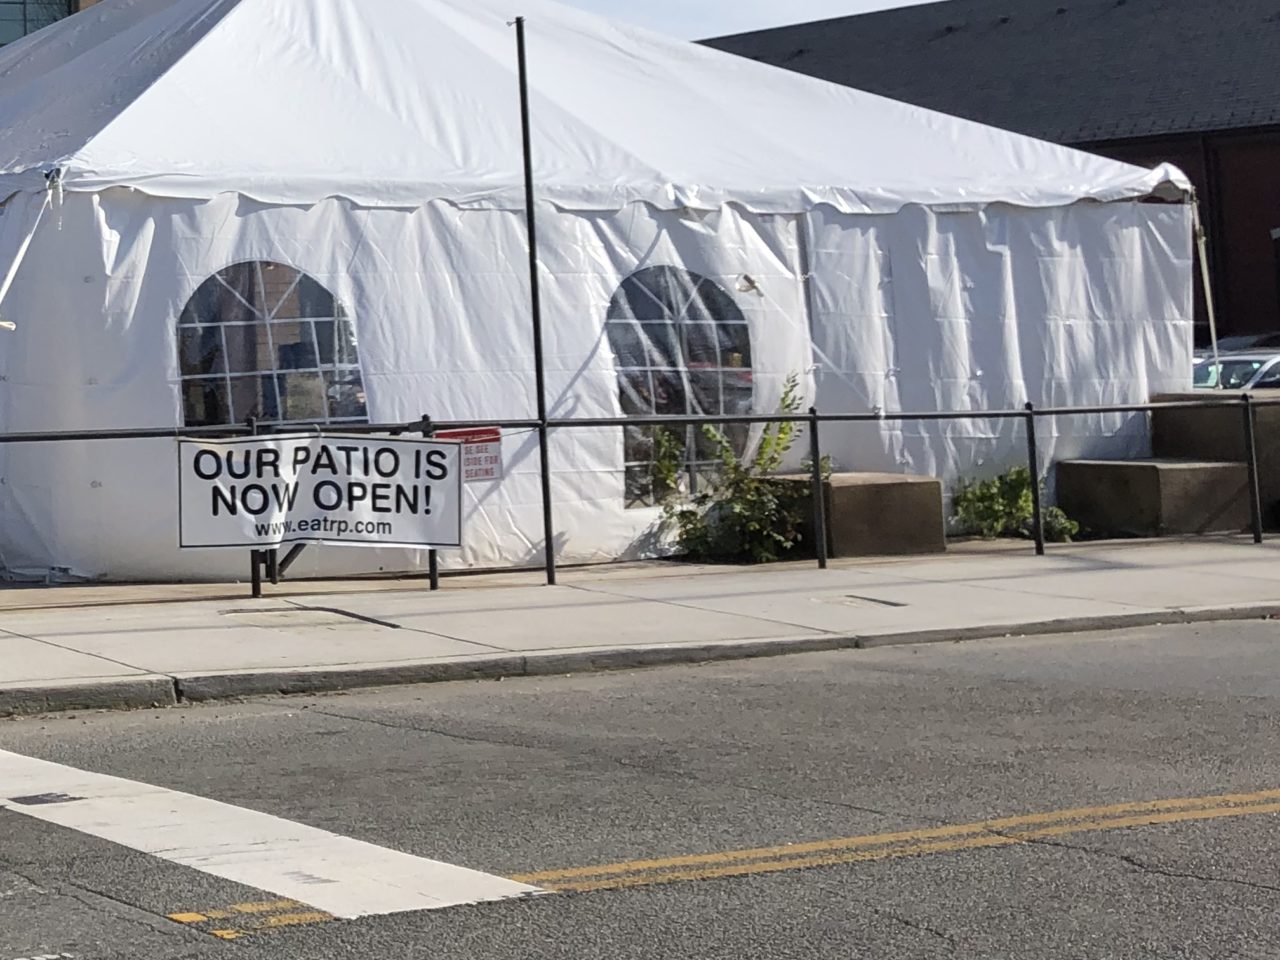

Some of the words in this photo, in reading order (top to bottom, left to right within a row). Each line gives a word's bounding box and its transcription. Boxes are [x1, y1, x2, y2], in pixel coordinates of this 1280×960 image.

[193, 448, 280, 481] OUR
[292, 444, 400, 478] PATIO
[414, 449, 448, 481] IS
[211, 481, 299, 517] NOW
[312, 479, 432, 515] OPEN!
[255, 516, 392, 537] www.eatrp.com
